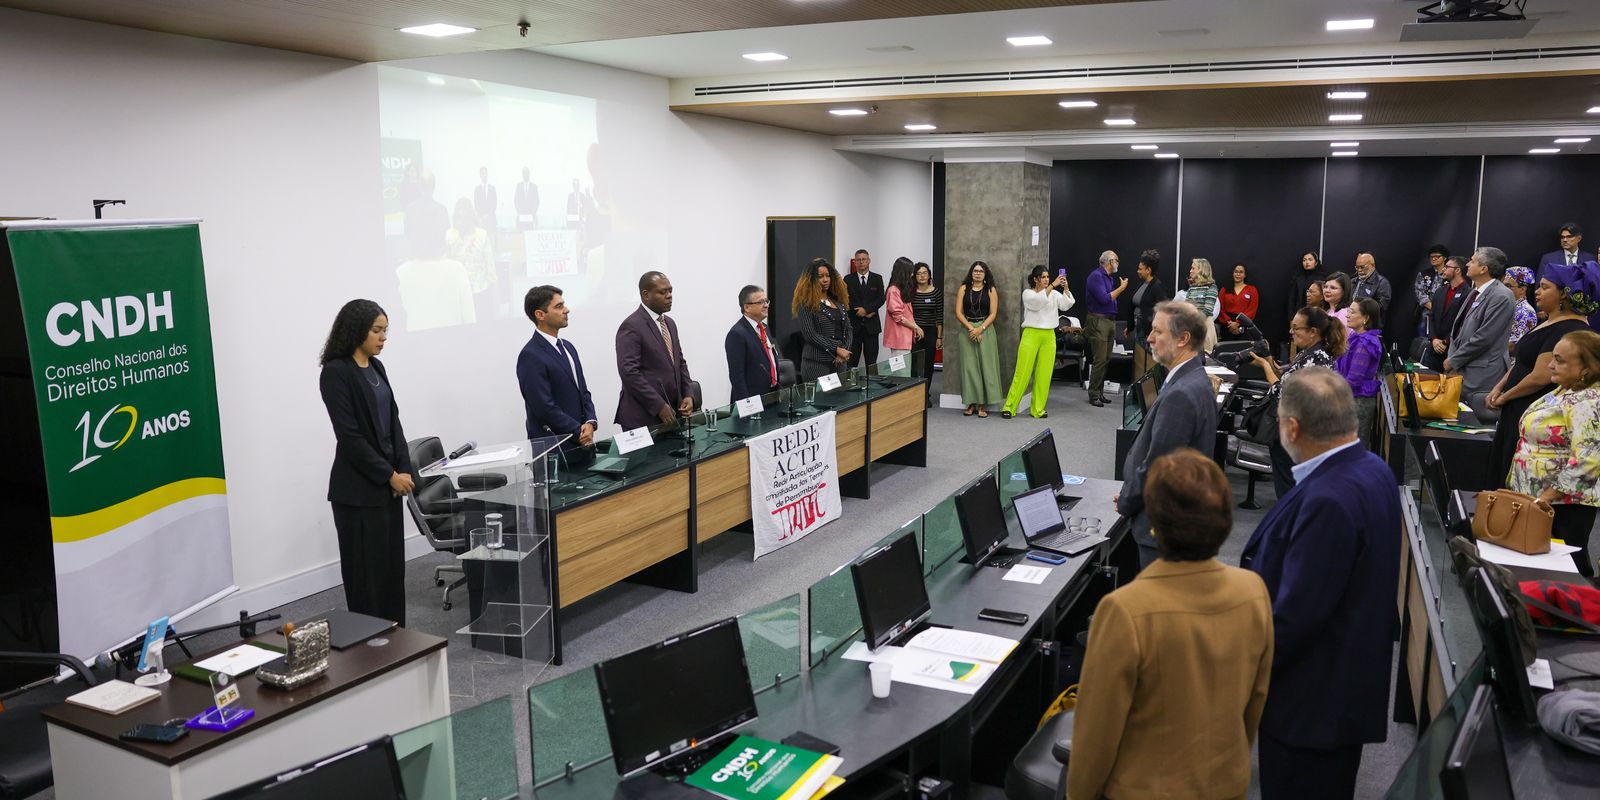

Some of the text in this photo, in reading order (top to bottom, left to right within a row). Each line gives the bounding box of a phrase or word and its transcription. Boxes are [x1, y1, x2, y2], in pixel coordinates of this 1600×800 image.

[45, 290, 174, 347] CNDH
[45, 343, 188, 381] Conselho Nacional dos
[47, 360, 190, 402] Direitos Humanos
[68, 403, 191, 473] 10 ANOS
[772, 422, 821, 457] REDE
[773, 443, 820, 479] ACTP
[775, 499, 785, 508] de
[711, 747, 759, 783] CNDH
